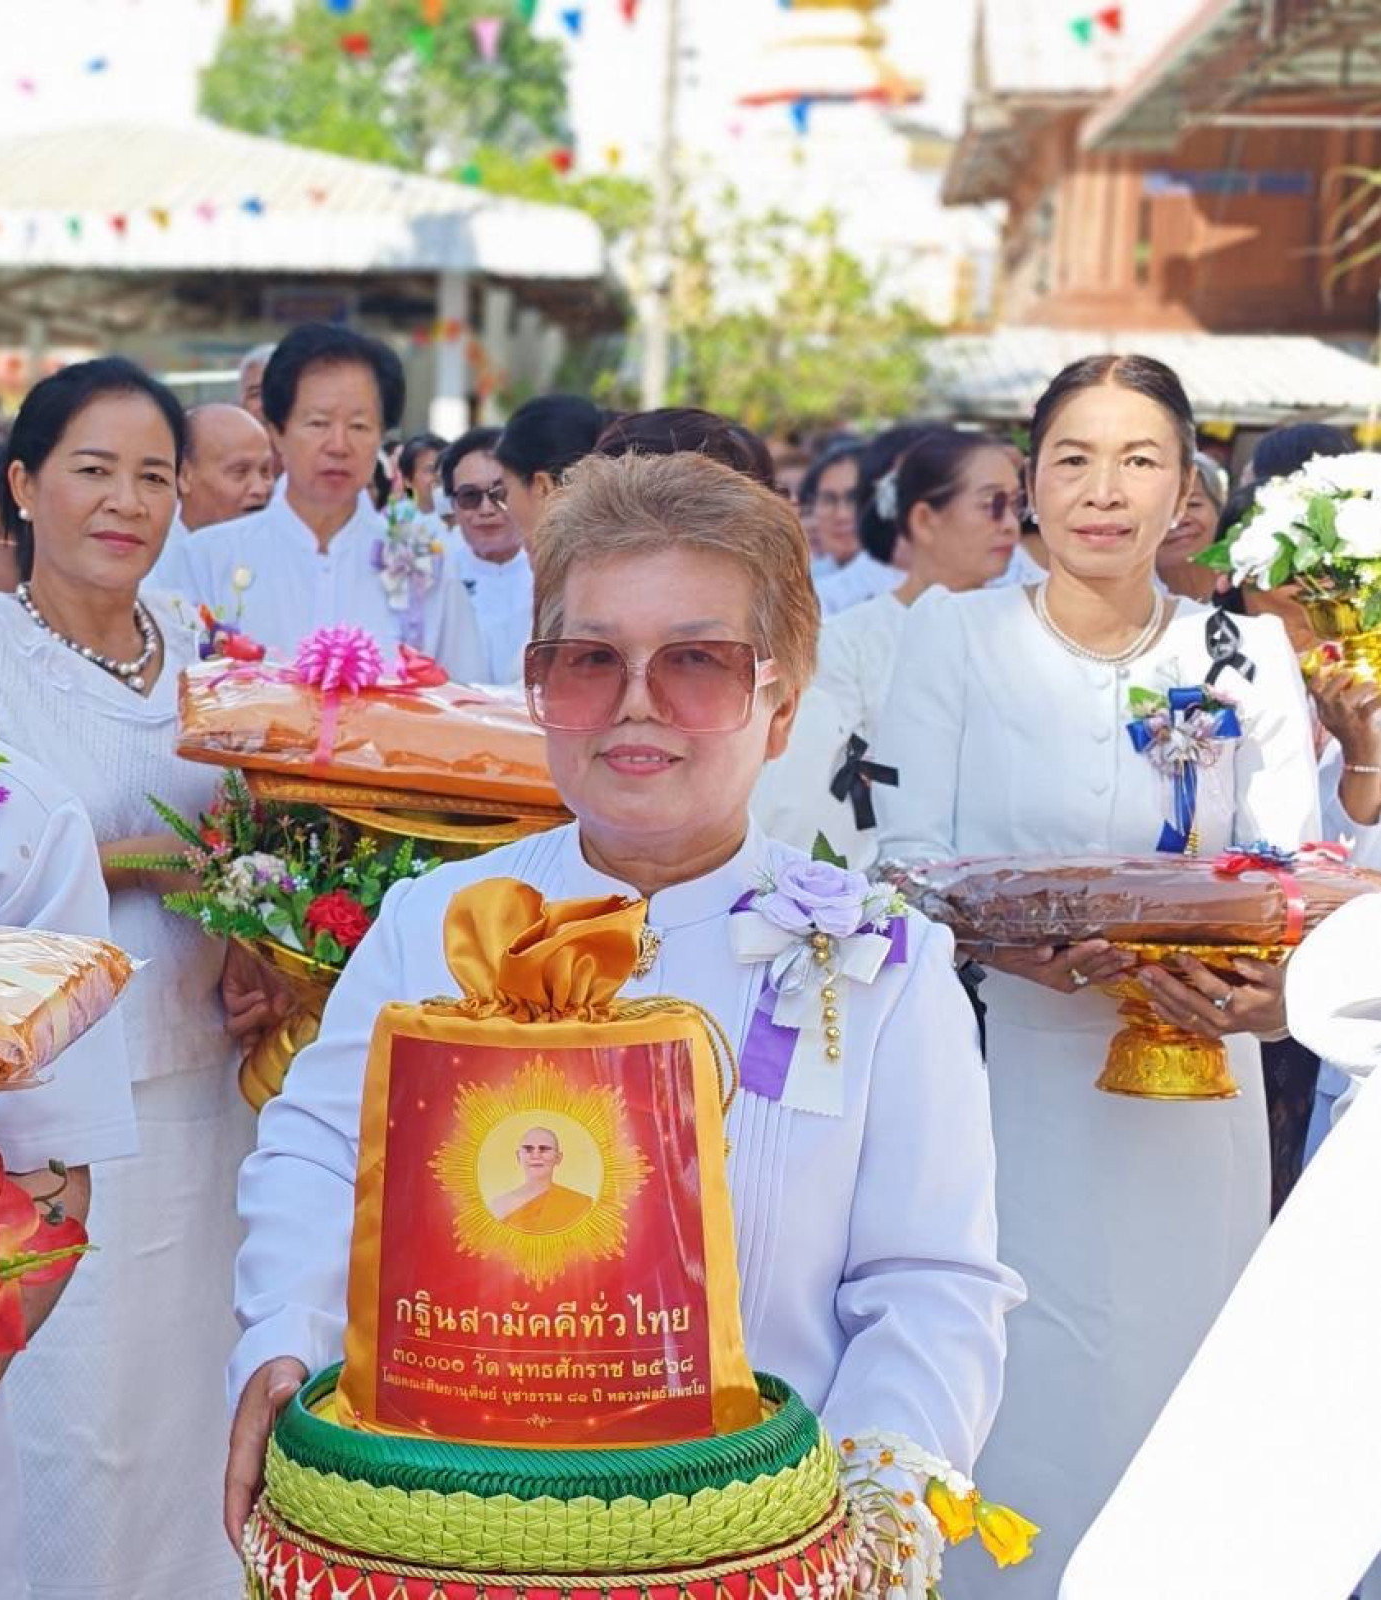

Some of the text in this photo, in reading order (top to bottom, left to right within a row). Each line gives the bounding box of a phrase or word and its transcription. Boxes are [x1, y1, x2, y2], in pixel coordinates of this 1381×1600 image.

[396, 1290, 690, 1339] กฐินสามัคคีทั่วไทย
[473, 1352, 500, 1376] วัด
[507, 1357, 625, 1385] พุทธศักราช
[632, 1354, 694, 1377] ๒๕๖๘
[592, 1386, 603, 1403] ปี
